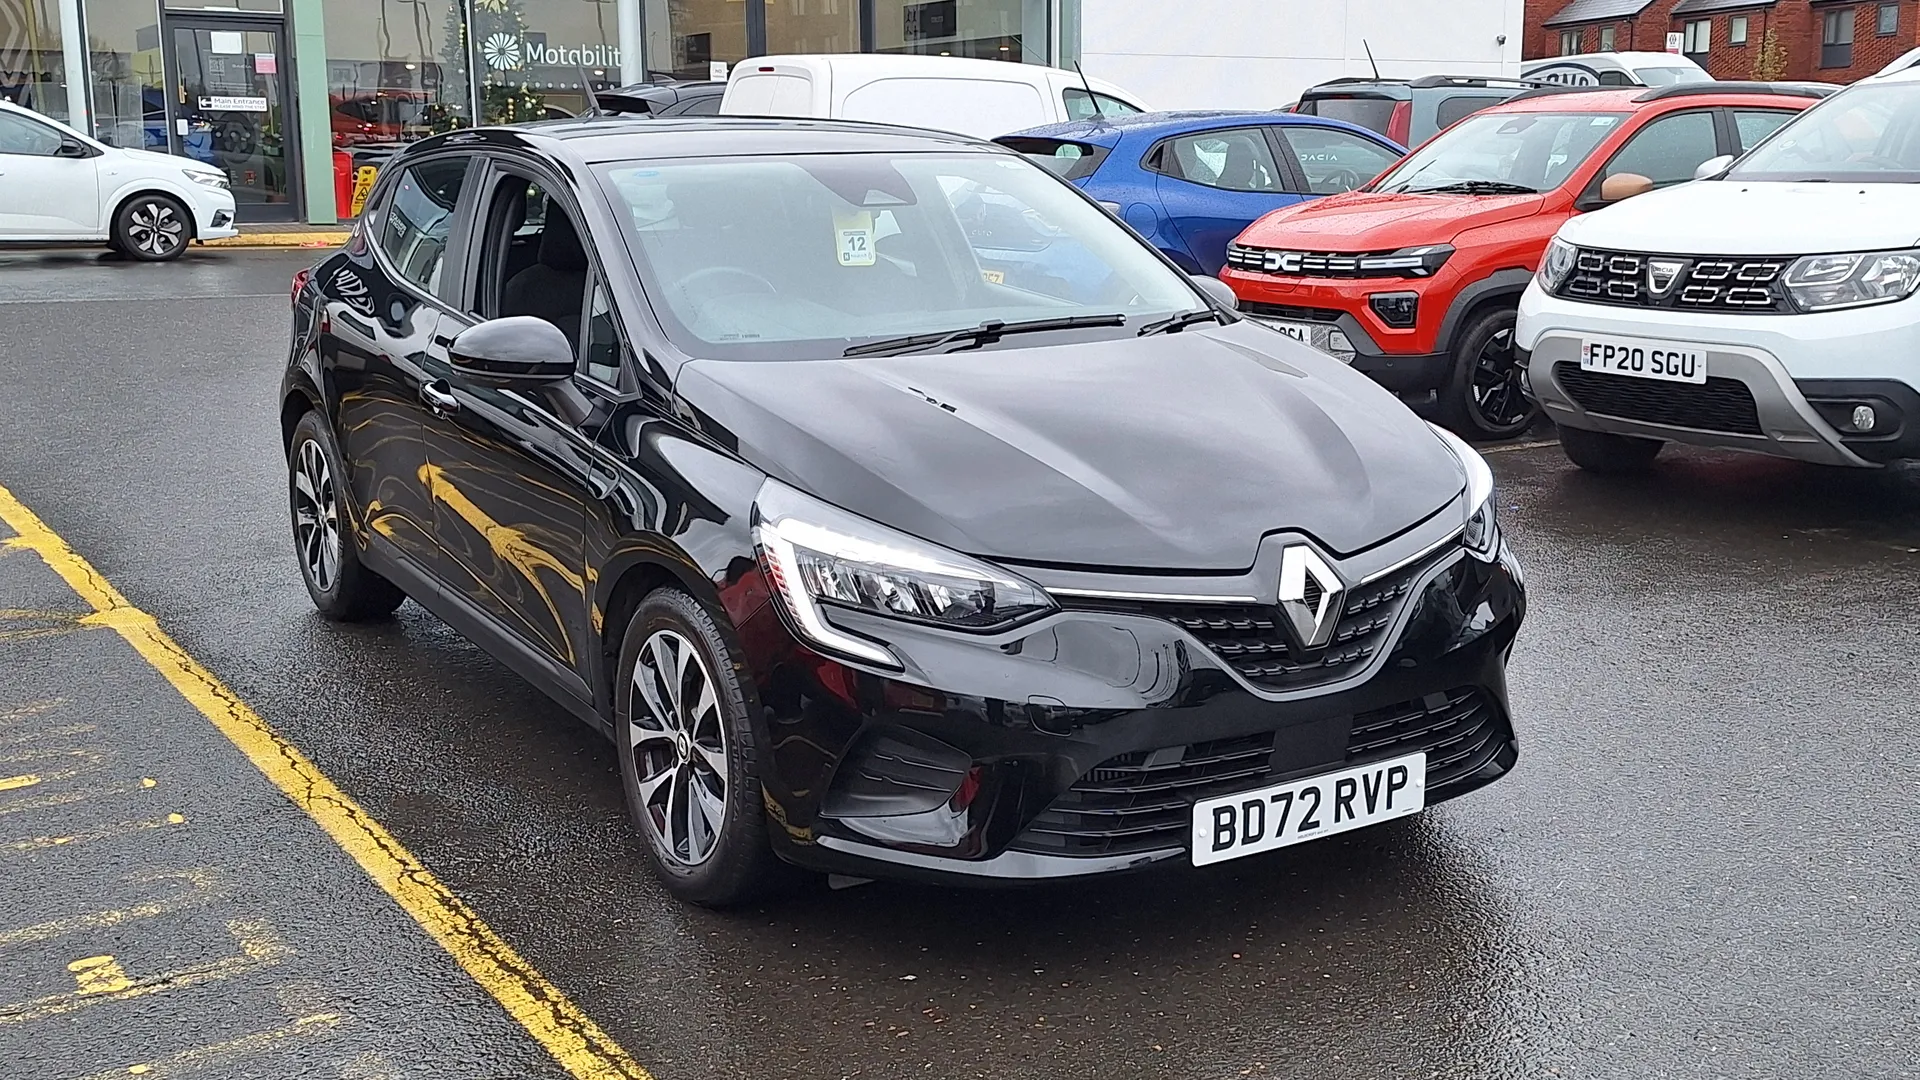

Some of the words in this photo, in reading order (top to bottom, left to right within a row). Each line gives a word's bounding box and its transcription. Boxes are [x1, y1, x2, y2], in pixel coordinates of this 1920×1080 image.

[848, 236, 866, 251] 12
[1590, 343, 1644, 372] FP20
[1651, 350, 1696, 378] SGU
[1212, 786, 1321, 853] BD72
[1334, 764, 1408, 824] RVP
